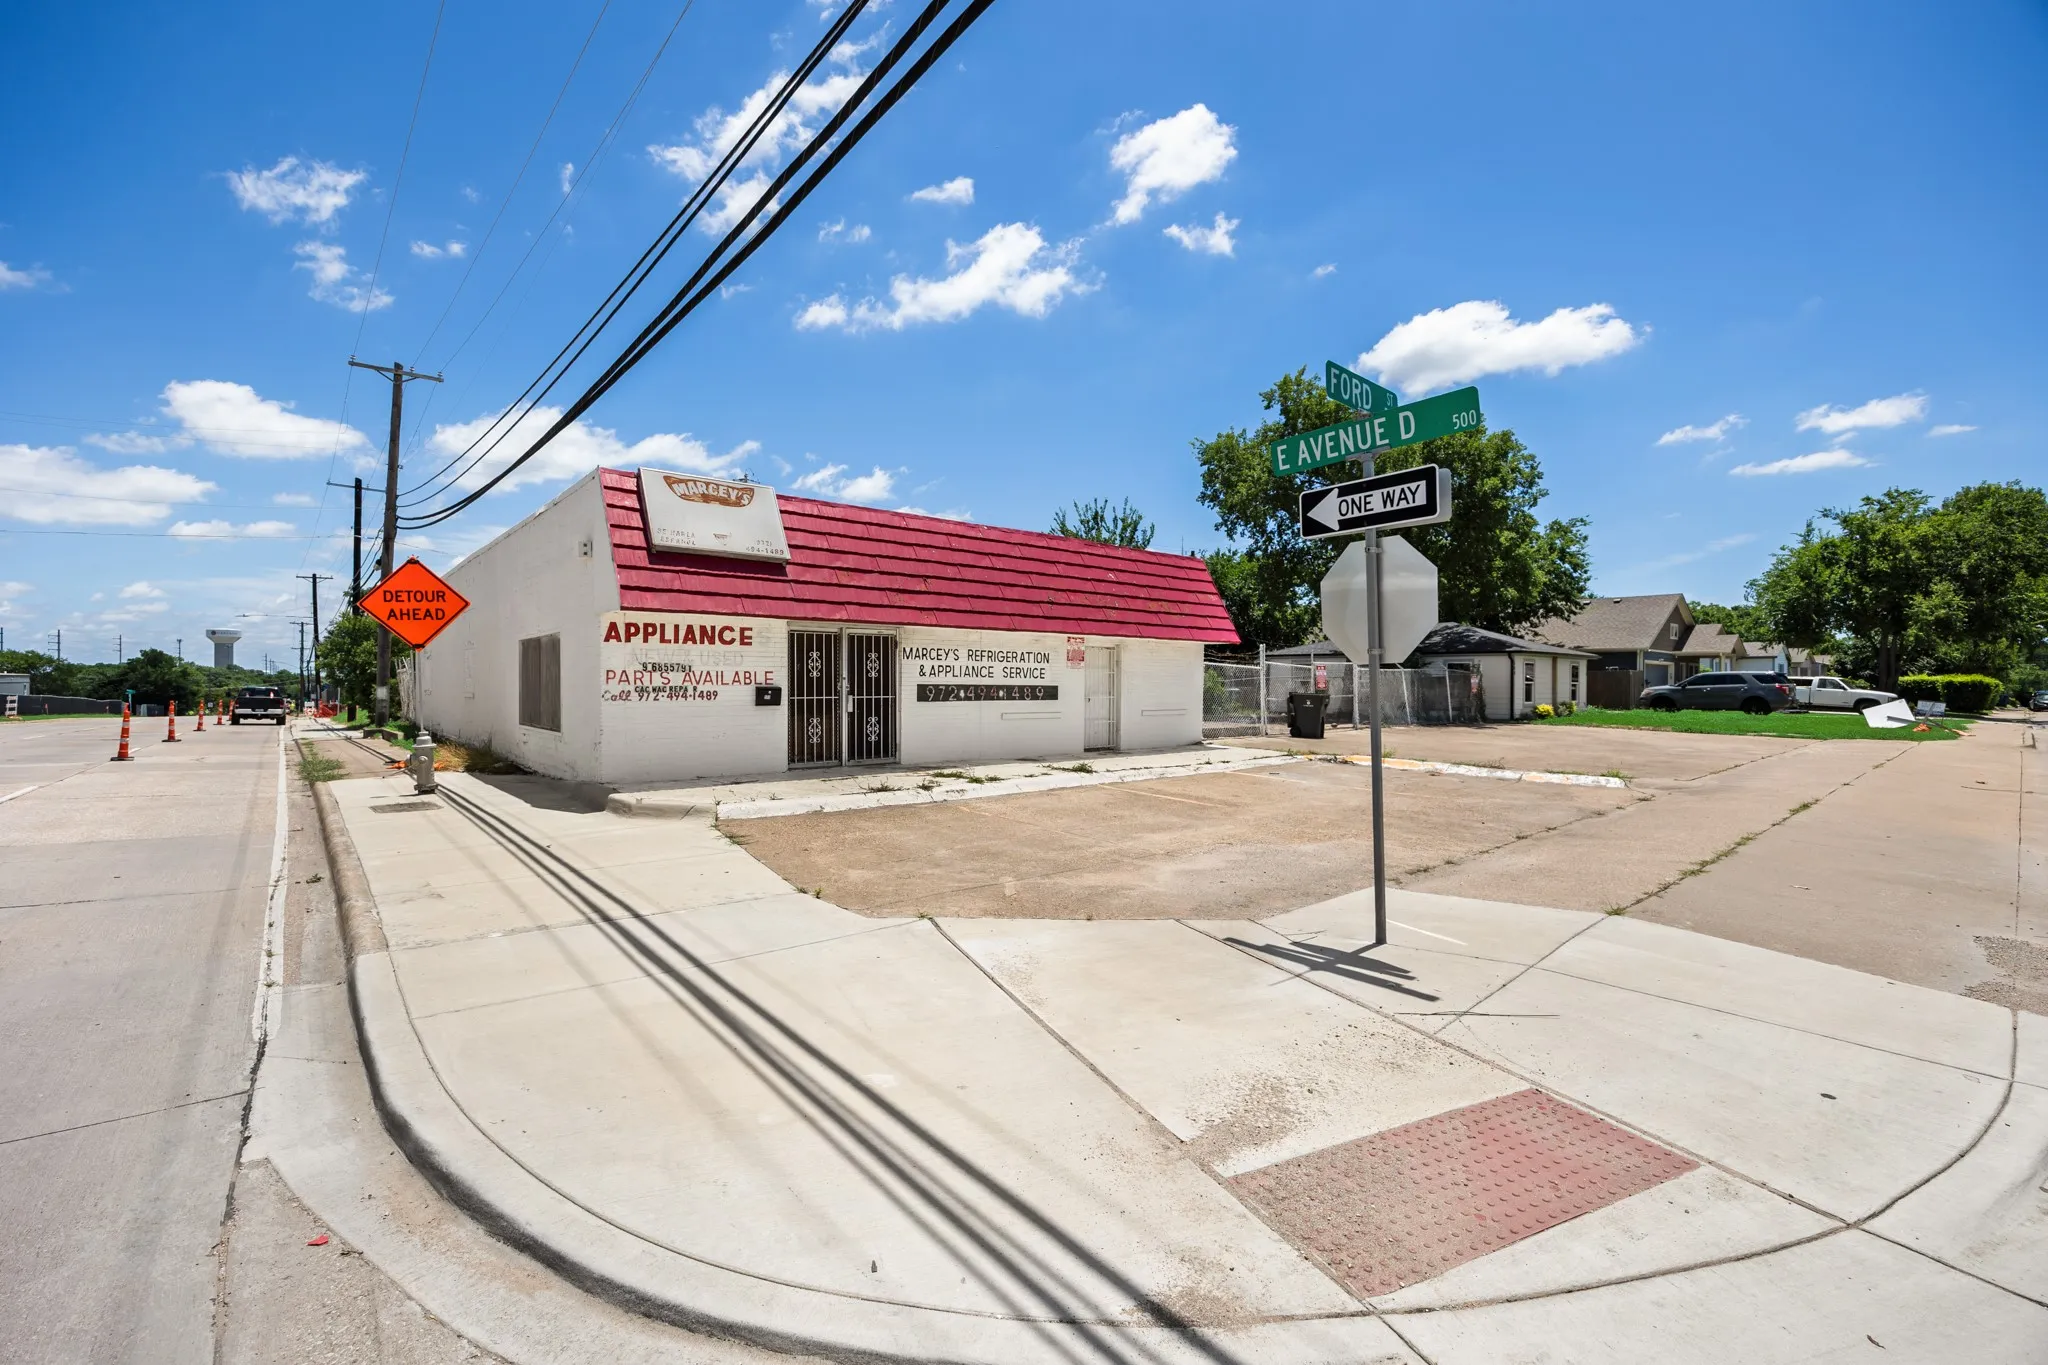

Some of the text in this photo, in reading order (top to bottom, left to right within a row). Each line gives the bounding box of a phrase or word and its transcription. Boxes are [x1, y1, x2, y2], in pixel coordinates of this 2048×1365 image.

[1330, 367, 1394, 410] FORD ST
[1276, 409, 1478, 471] E AVENUE D 500
[671, 480, 752, 506] MARCEY'S
[1338, 483, 1422, 517] ONE WAY
[383, 590, 446, 602] DETOUR
[387, 608, 445, 620] AHEAD
[603, 621, 753, 646] APPLIANCE
[902, 647, 960, 662] MARCEY'S
[967, 649, 1050, 664] REFRIGERATION
[605, 669, 774, 686] PARTS AVAILABLE
[918, 664, 1046, 680] & APPLIANCE SERVICE
[601, 689, 633, 702] Call
